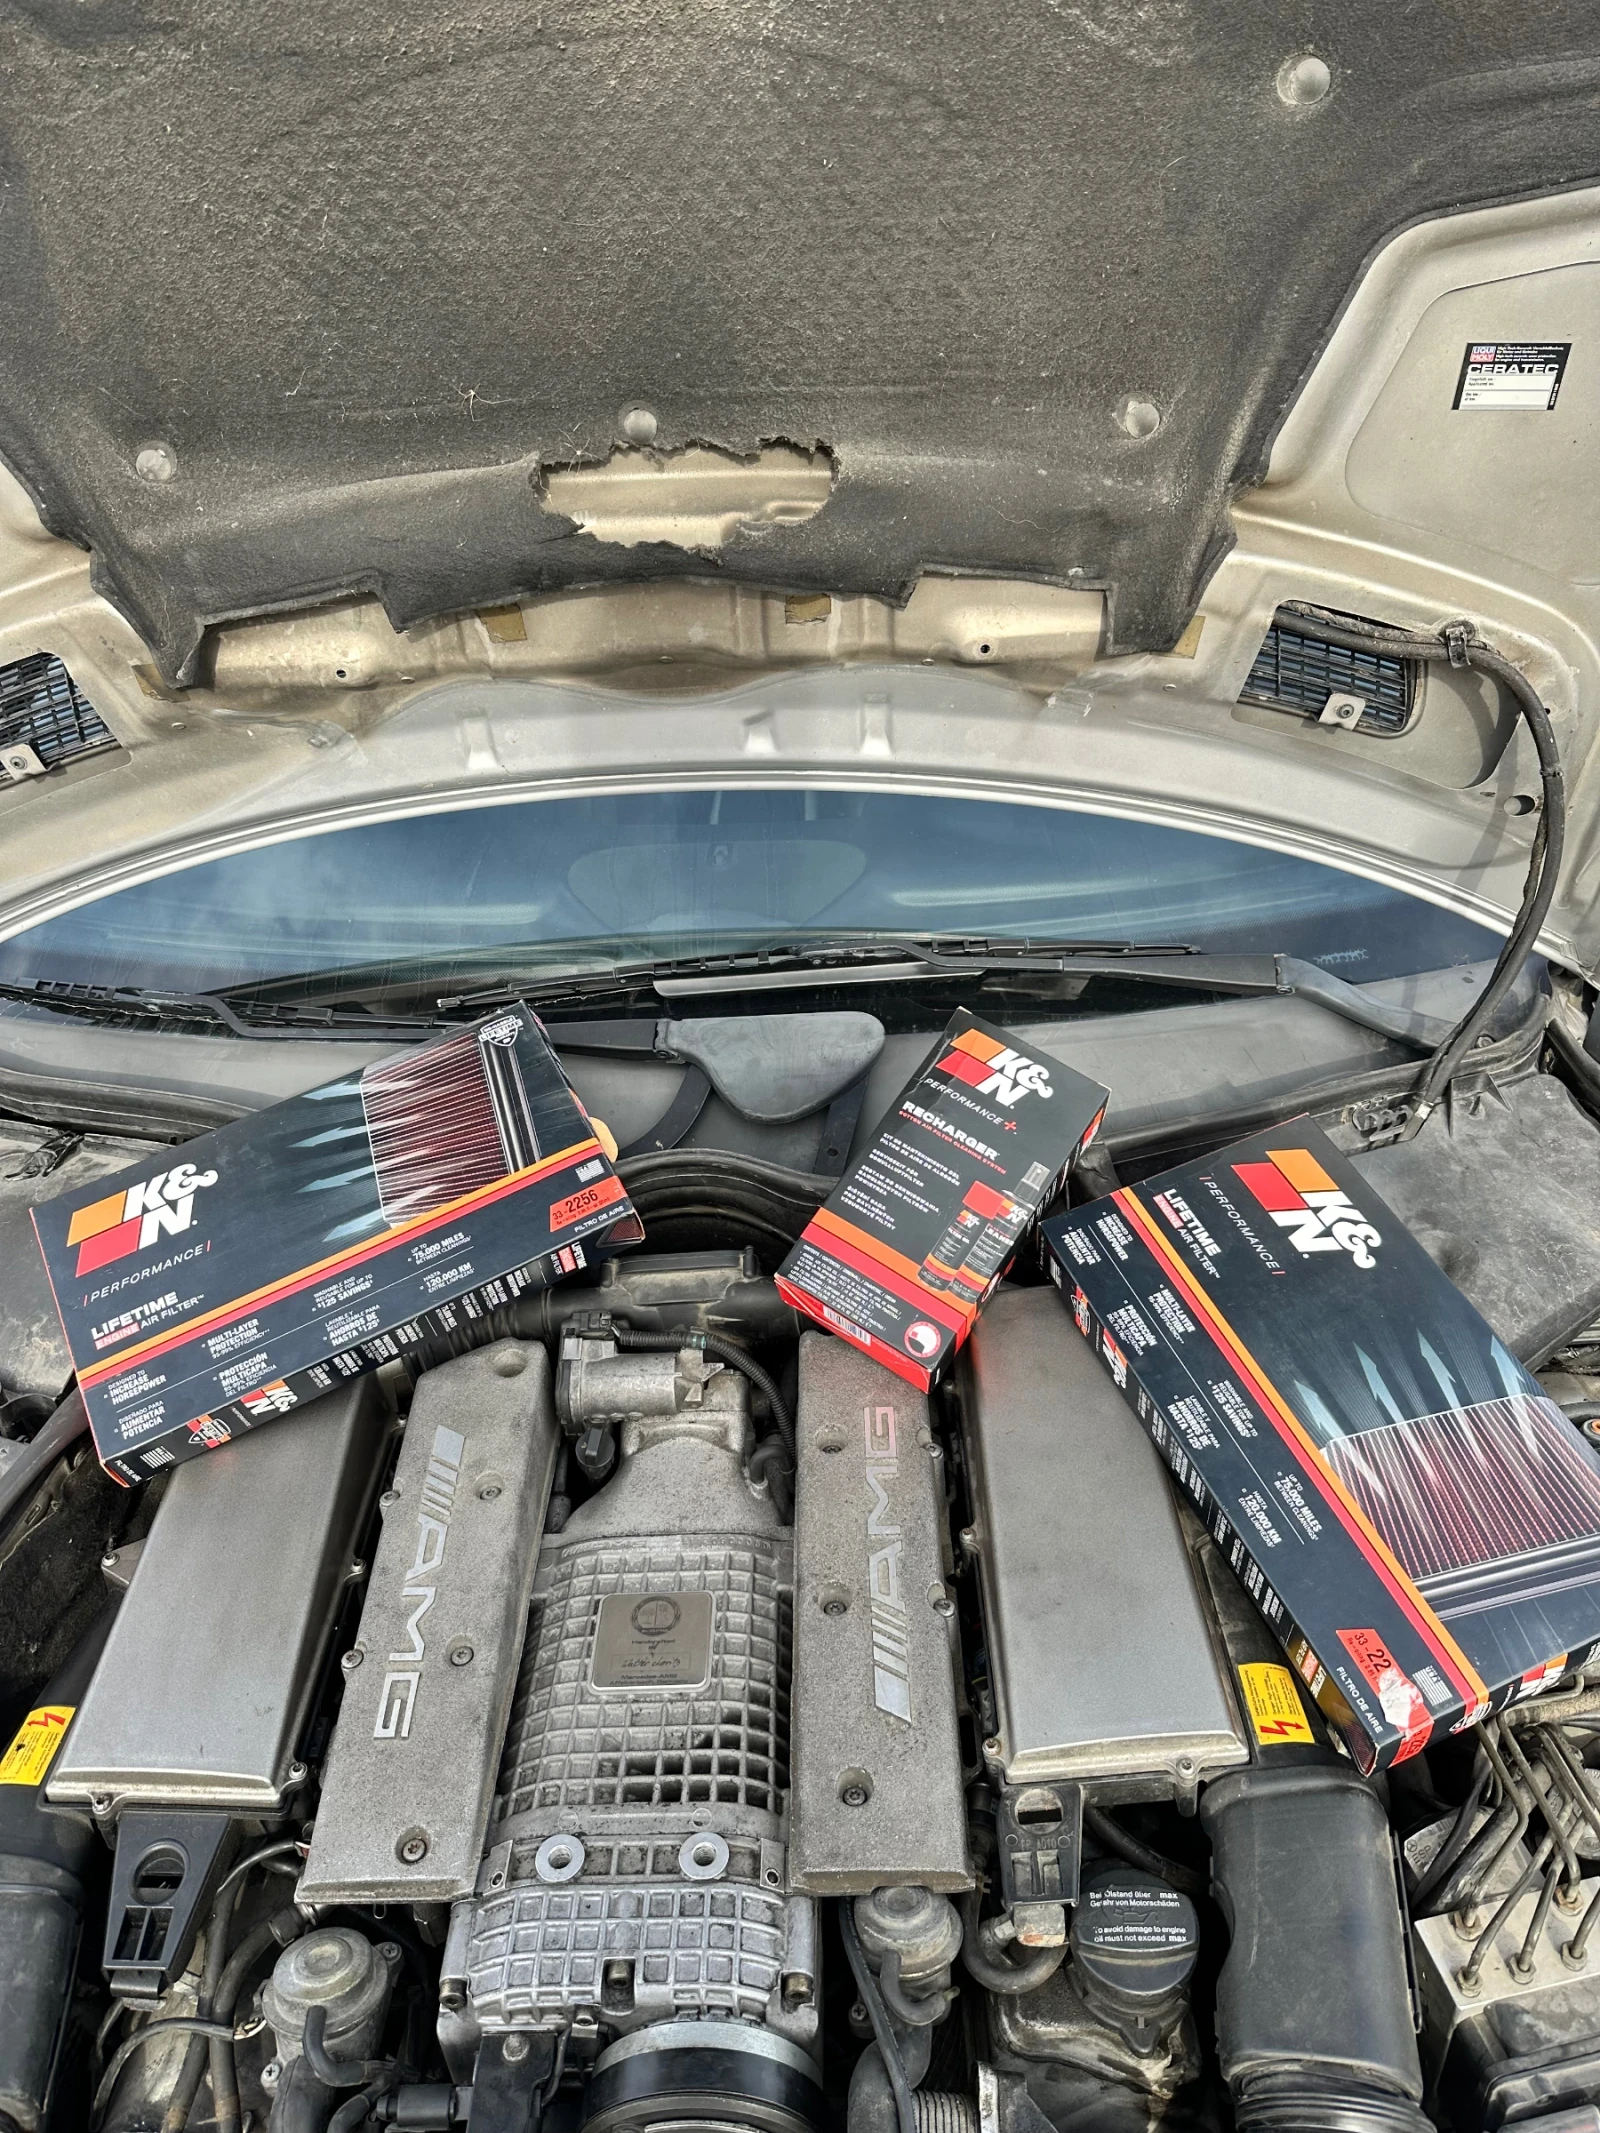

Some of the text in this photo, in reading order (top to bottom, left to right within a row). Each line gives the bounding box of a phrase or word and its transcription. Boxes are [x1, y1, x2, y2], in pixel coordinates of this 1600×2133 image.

[1468, 364, 1559, 374] CERATEC
[898, 1110, 1007, 1175] COTTON AIR FILTER CLEANING SYSTEM
[902, 1101, 999, 1161] RECHARGER
[872, 1148, 907, 1170] SERVICEKIT
[880, 1138, 901, 1151] FILTRO
[900, 1148, 909, 1156] DE
[909, 1153, 924, 1165] AIRE
[924, 1160, 933, 1169] DE
[883, 1132, 960, 1180] KIT DE MANTENIMIENTO DEL
[854, 1174, 888, 1197] POWIETRZA
[861, 1164, 886, 1181] ZESTAW
[844, 1190, 857, 1200] PRO
[574, 1206, 625, 1233] FILTRO DE AIRE
[875, 1215, 896, 1231] FILTRY
[1104, 1216, 1129, 1247] INCREASE
[1110, 1213, 1134, 1242] DESIGNED TO
[1154, 1194, 1184, 1230] ENGINE
[1178, 1228, 1194, 1246] AIR
[1164, 1188, 1222, 1257] LIFETIME
[411, 1243, 428, 1254] UP TO
[412, 1232, 465, 1260] 75,000 MILES
[1061, 1234, 1086, 1266] POTENCIA
[1069, 1232, 1097, 1266] AUMENTAR
[1076, 1228, 1102, 1263] DISEÑADO PARA
[1096, 1219, 1129, 1261] HORSEPOWER
[416, 1250, 442, 1266] BETWEEN
[458, 1262, 473, 1273] KM
[314, 1276, 356, 1298] WASHABLE AND
[316, 1274, 373, 1303] REUSABLE FOR UP TO
[424, 1270, 441, 1282] HASTA
[428, 1282, 446, 1293] ENTRE
[91, 1292, 178, 1341] LIFETIME
[318, 1298, 337, 1309] $125
[1152, 1292, 1186, 1334] PROTECTION
[1160, 1288, 1196, 1333] MULTI-LAYER
[325, 1314, 348, 1328] LAVABLE
[326, 1304, 381, 1333] REUTILIZABLE PARA
[329, 1312, 378, 1341] AHORROS DE
[1106, 1314, 1116, 1325] DEL
[1117, 1308, 1148, 1348] MULTICAPA
[1125, 1304, 1158, 1347] PROTECCIÓN
[96, 1315, 160, 1350] ENGINE AIR
[207, 1318, 260, 1348] MULTI-LAYER
[210, 1328, 258, 1354] PROTECTION
[331, 1331, 359, 1347] HASTA
[108, 1370, 146, 1390] DESIGNED TO
[218, 1352, 269, 1381] PROTECCIÓN
[221, 1362, 268, 1388] MULTICAPA
[110, 1374, 150, 1398] INCREASE
[112, 1374, 167, 1406] HORSEPOWER
[226, 1388, 238, 1398] DEL
[1212, 1384, 1228, 1405] $125
[118, 1400, 164, 1425] DISEÑADO PARA
[1188, 1394, 1208, 1419] LAVABLE
[1218, 1382, 1241, 1411] REUSABLE
[1237, 1408, 1248, 1421] FOR
[1250, 1426, 1258, 1437] TO
[1224, 1380, 1254, 1420] WASHABLE AND
[121, 1406, 166, 1432] AUMENTAR
[123, 1418, 164, 1440] POTENCIA
[1167, 1404, 1189, 1431] HASTA
[1175, 1401, 1204, 1436] AHORROS
[1199, 1434, 1212, 1448] DE
[1184, 1397, 1221, 1449] REUTILIZABLE PARA
[1274, 1480, 1295, 1509] BETWEEN
[1288, 1474, 1304, 1492] UP TO
[1238, 1498, 1253, 1519] ENTRE
[1252, 1490, 1269, 1511] HASTA
[1280, 1476, 1323, 1533] 75,000 MILES
[1267, 1528, 1283, 1545] KM
[1336, 1666, 1384, 1734] FILTRO DE AIRE
[1094, 1935, 1104, 1943] oil
[1124, 1926, 1153, 1935] damage
[1162, 1926, 1187, 1935] engine
